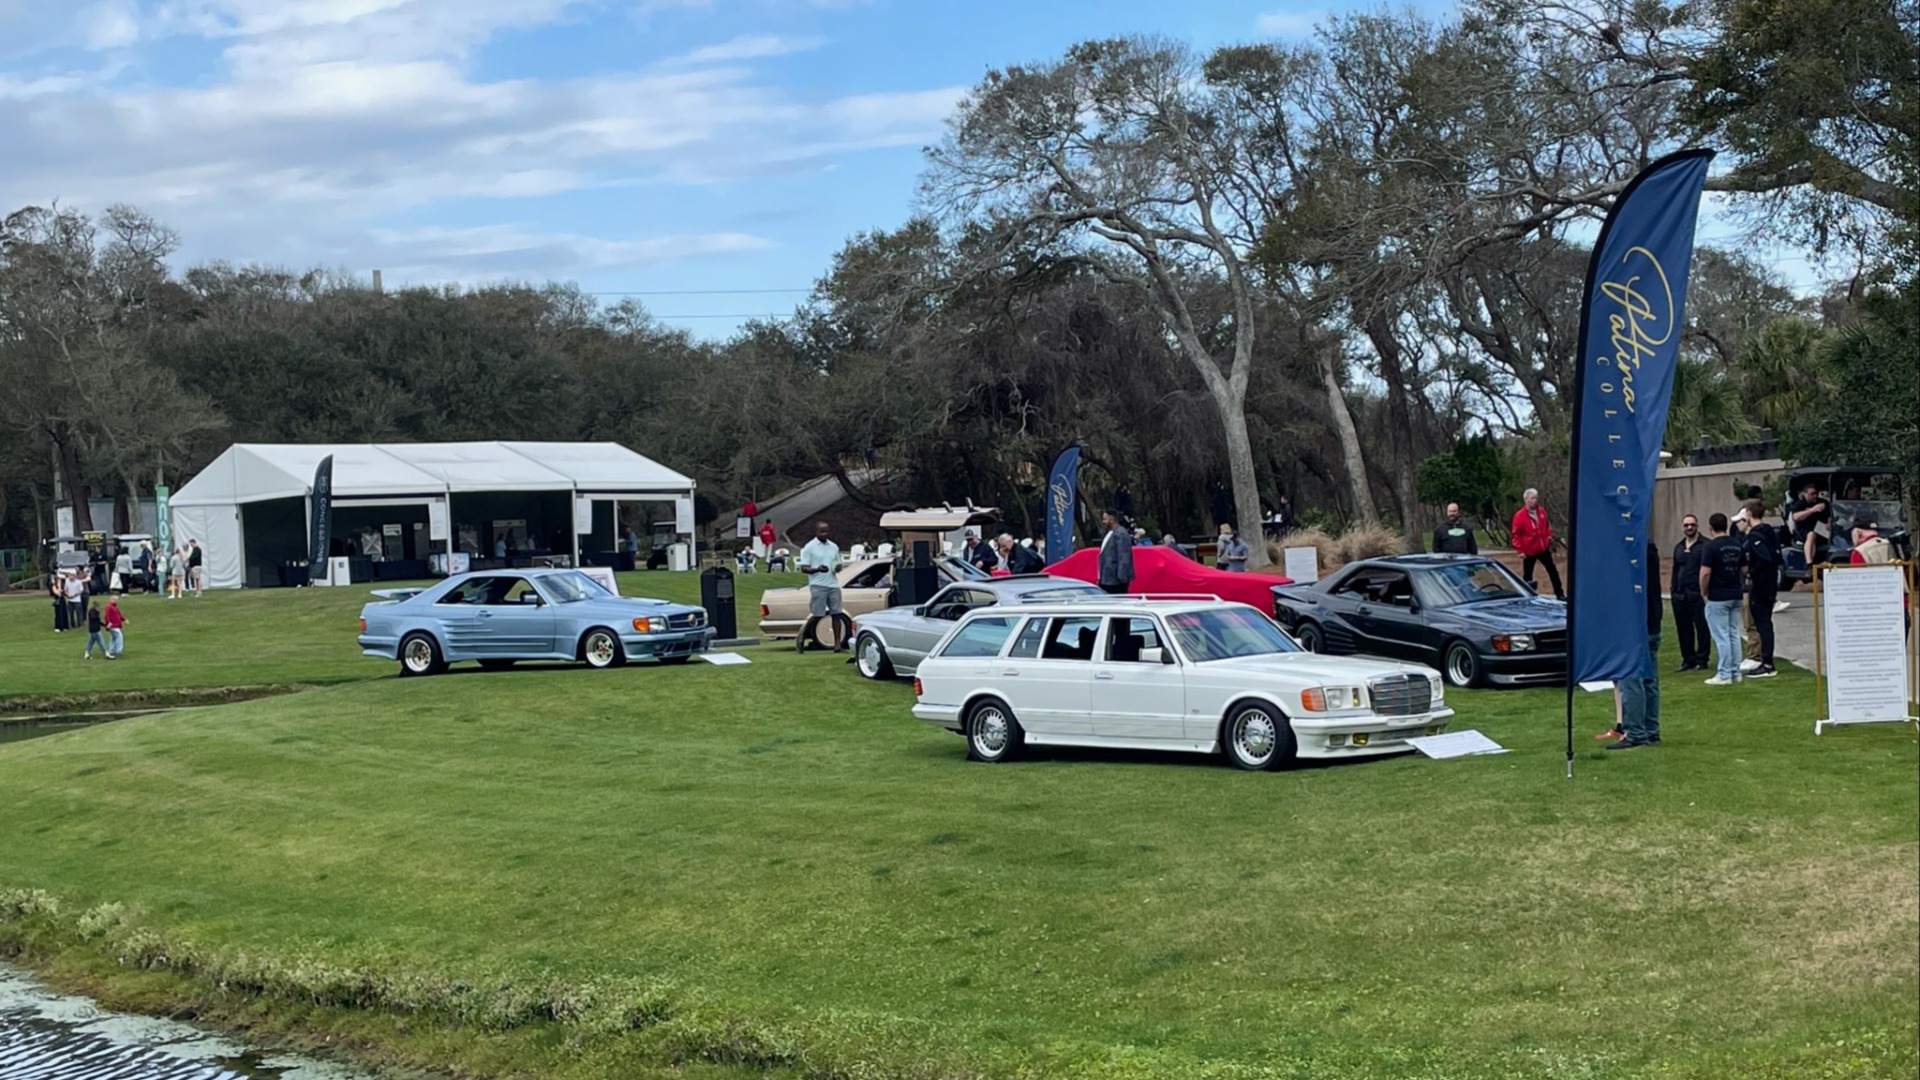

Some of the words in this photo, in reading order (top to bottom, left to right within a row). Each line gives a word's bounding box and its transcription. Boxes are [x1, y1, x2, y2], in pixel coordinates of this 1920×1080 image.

[1601, 246, 1674, 414] Patina
[159, 496, 170, 556] ICON
[317, 498, 327, 562] CONCESSIONS
[1596, 356, 1643, 594] COLLECTIVE
